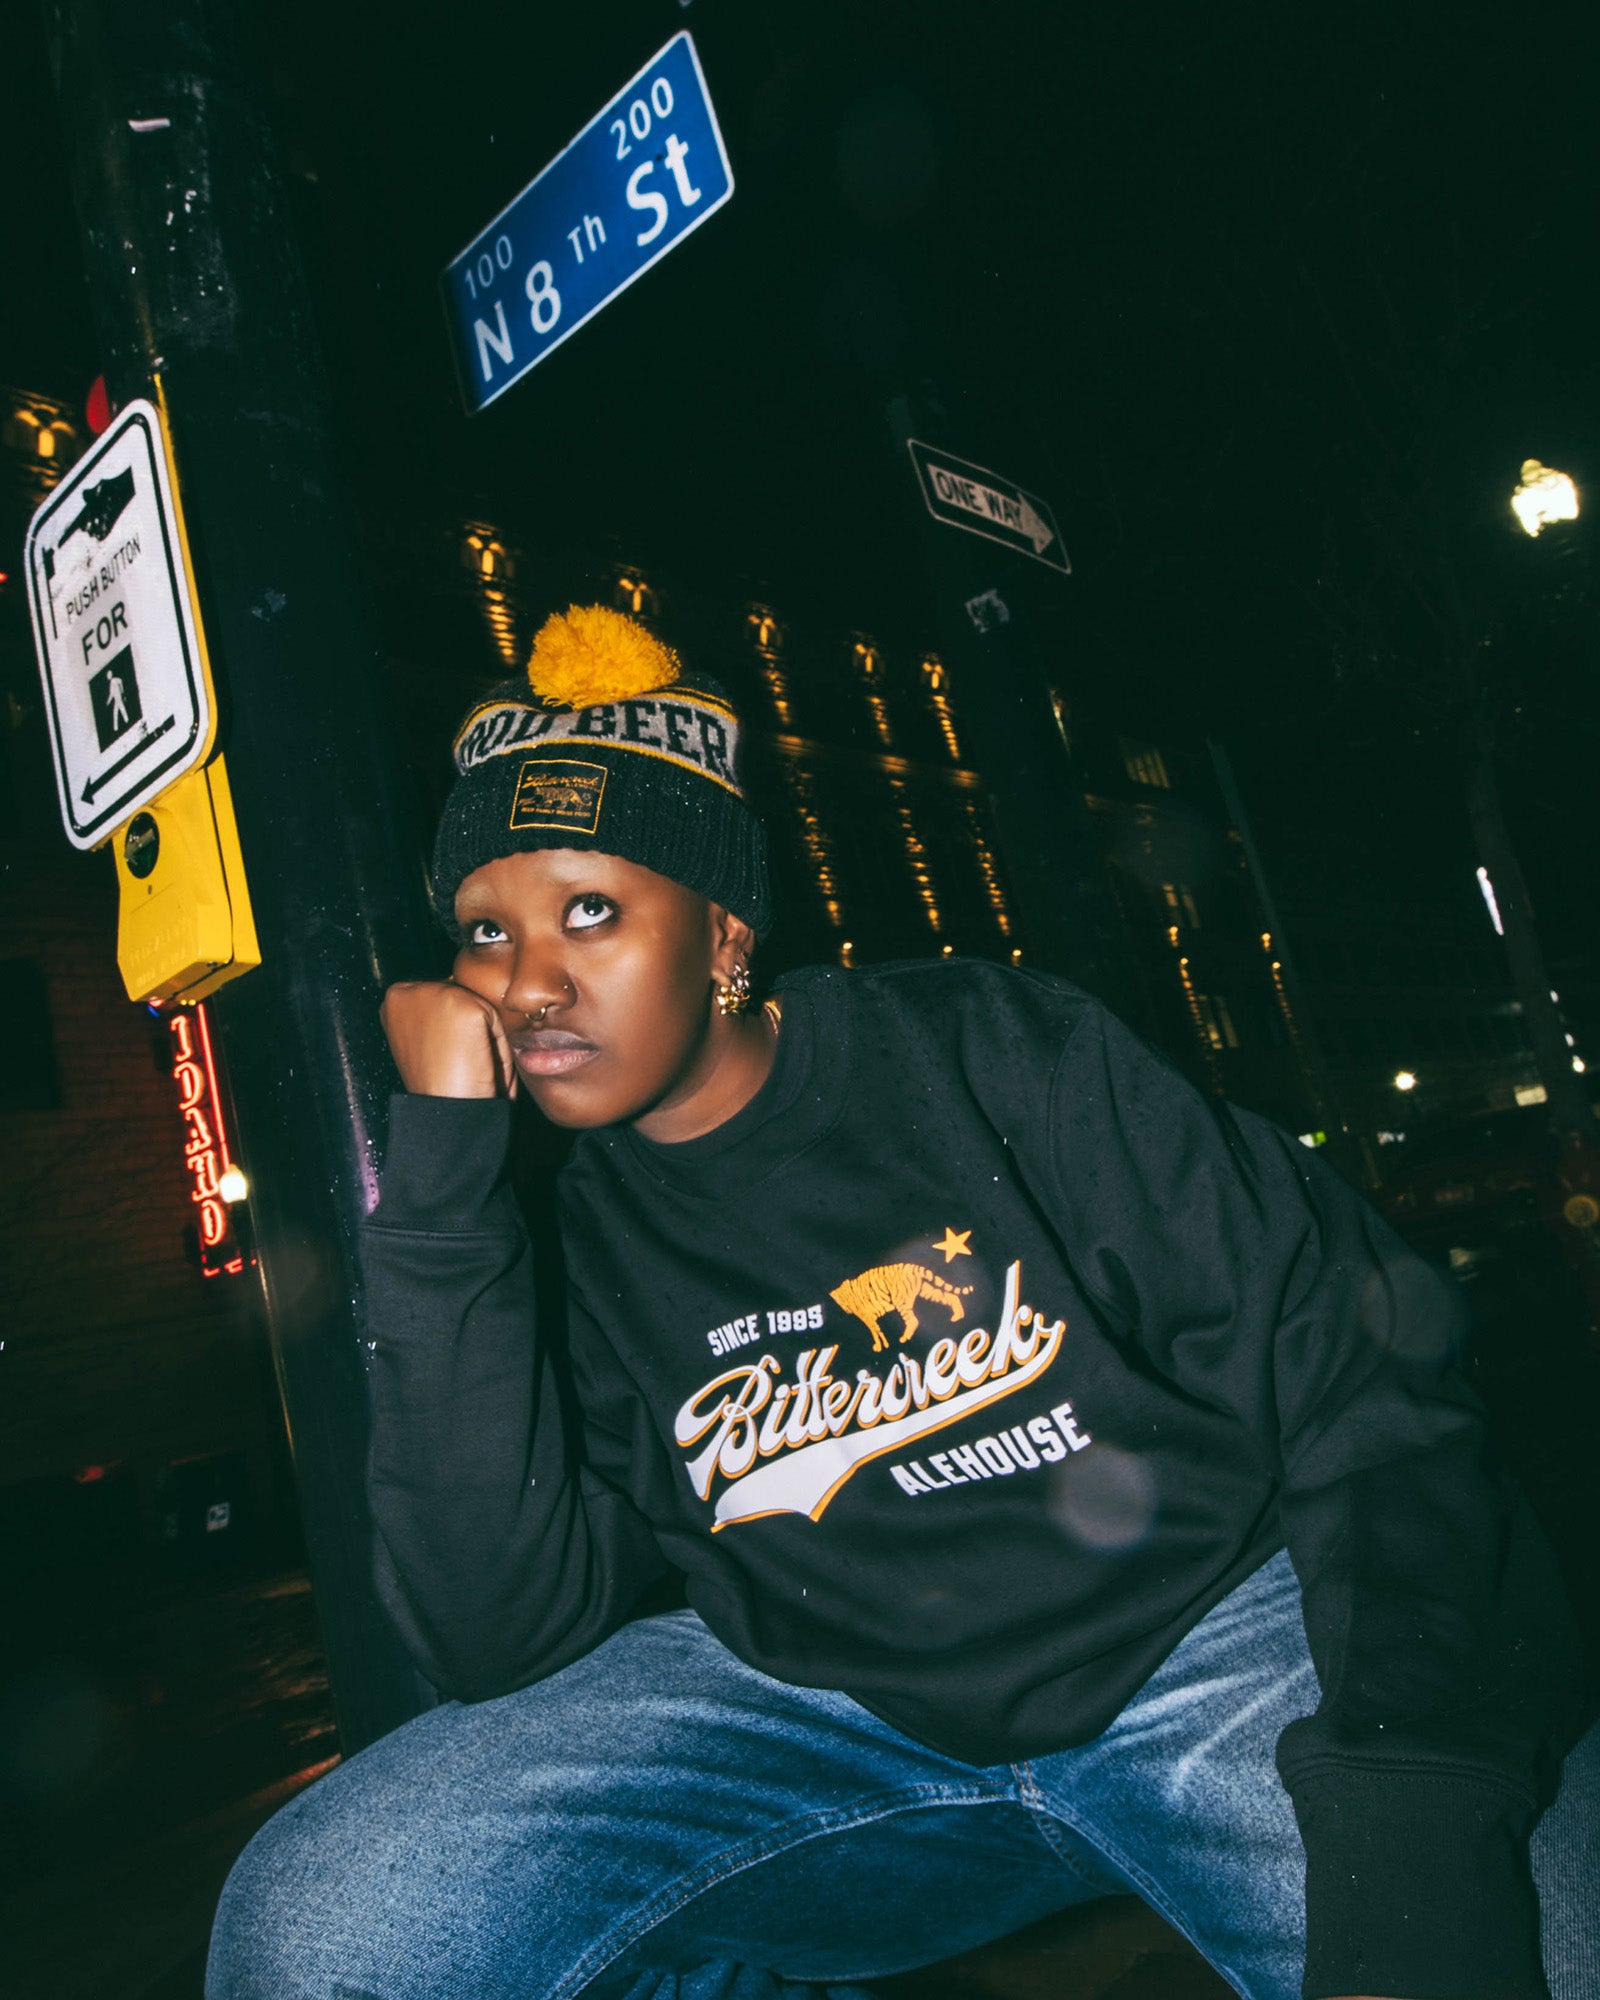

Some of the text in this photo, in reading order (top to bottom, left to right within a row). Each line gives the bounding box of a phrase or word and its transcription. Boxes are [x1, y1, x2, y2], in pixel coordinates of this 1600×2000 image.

[463, 77, 674, 298] 100 200
[474, 133, 702, 382] N 8 Th St
[936, 471, 1024, 531] ONE WAY
[66, 532, 141, 624] PUSH BUTTON
[82, 601, 128, 665] FOR
[569, 699, 738, 782] BEER
[707, 1303, 824, 1357] SINCE 1995
[675, 1260, 1066, 1501] Bittercreek
[890, 1402, 1091, 1497] ALEHOUSE
